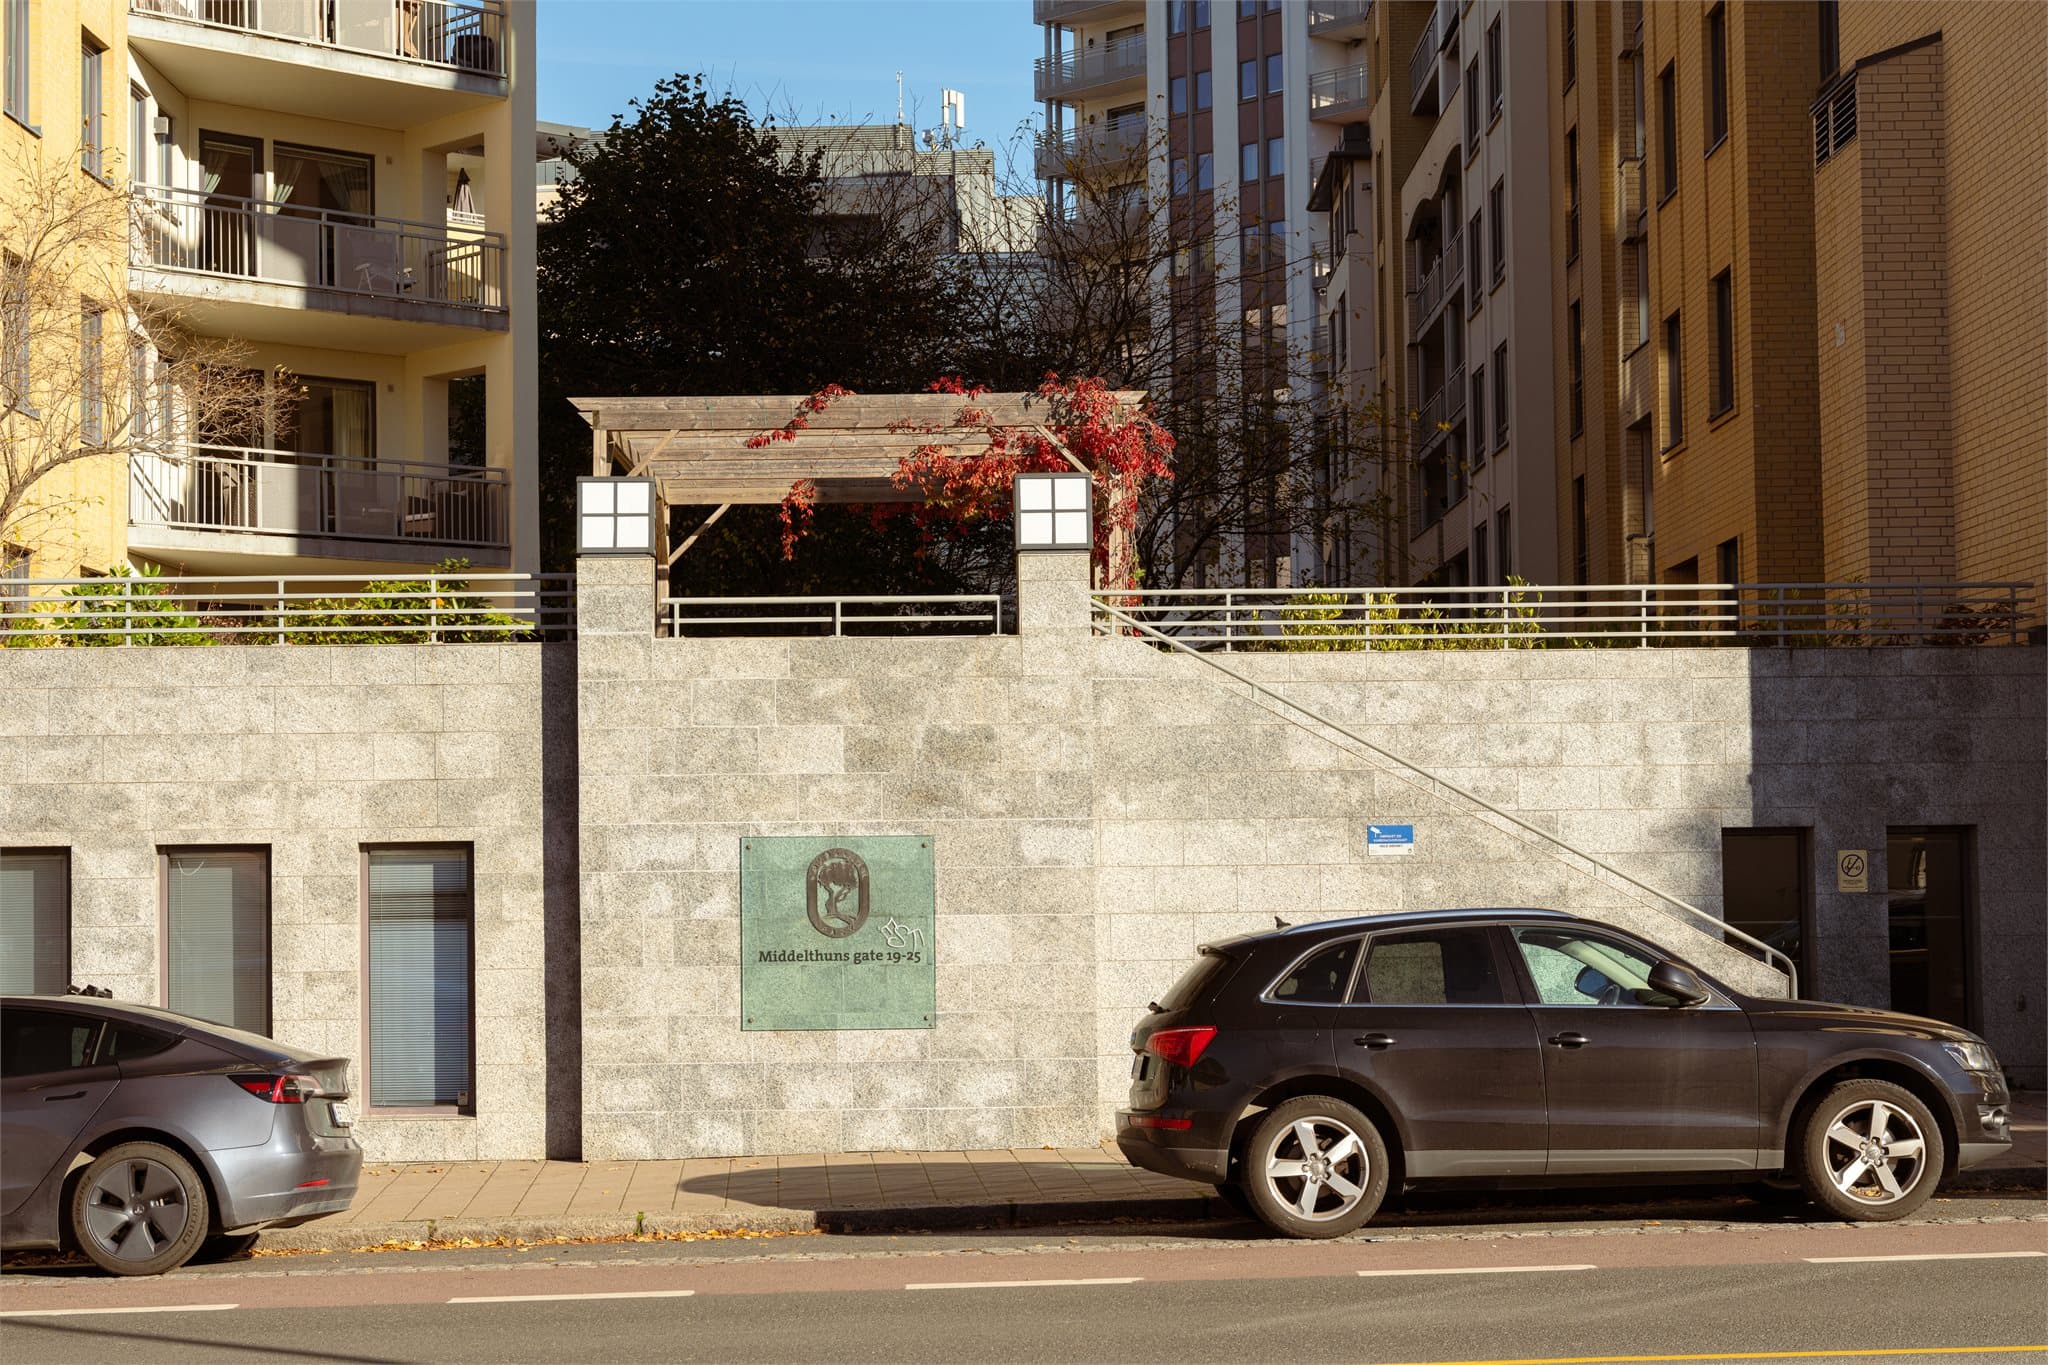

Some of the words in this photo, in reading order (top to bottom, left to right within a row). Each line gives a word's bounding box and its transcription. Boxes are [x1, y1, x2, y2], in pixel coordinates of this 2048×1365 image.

[758, 950, 850, 963] Middelthuns
[853, 951, 883, 965] gate
[886, 951, 921, 964] 19-25
